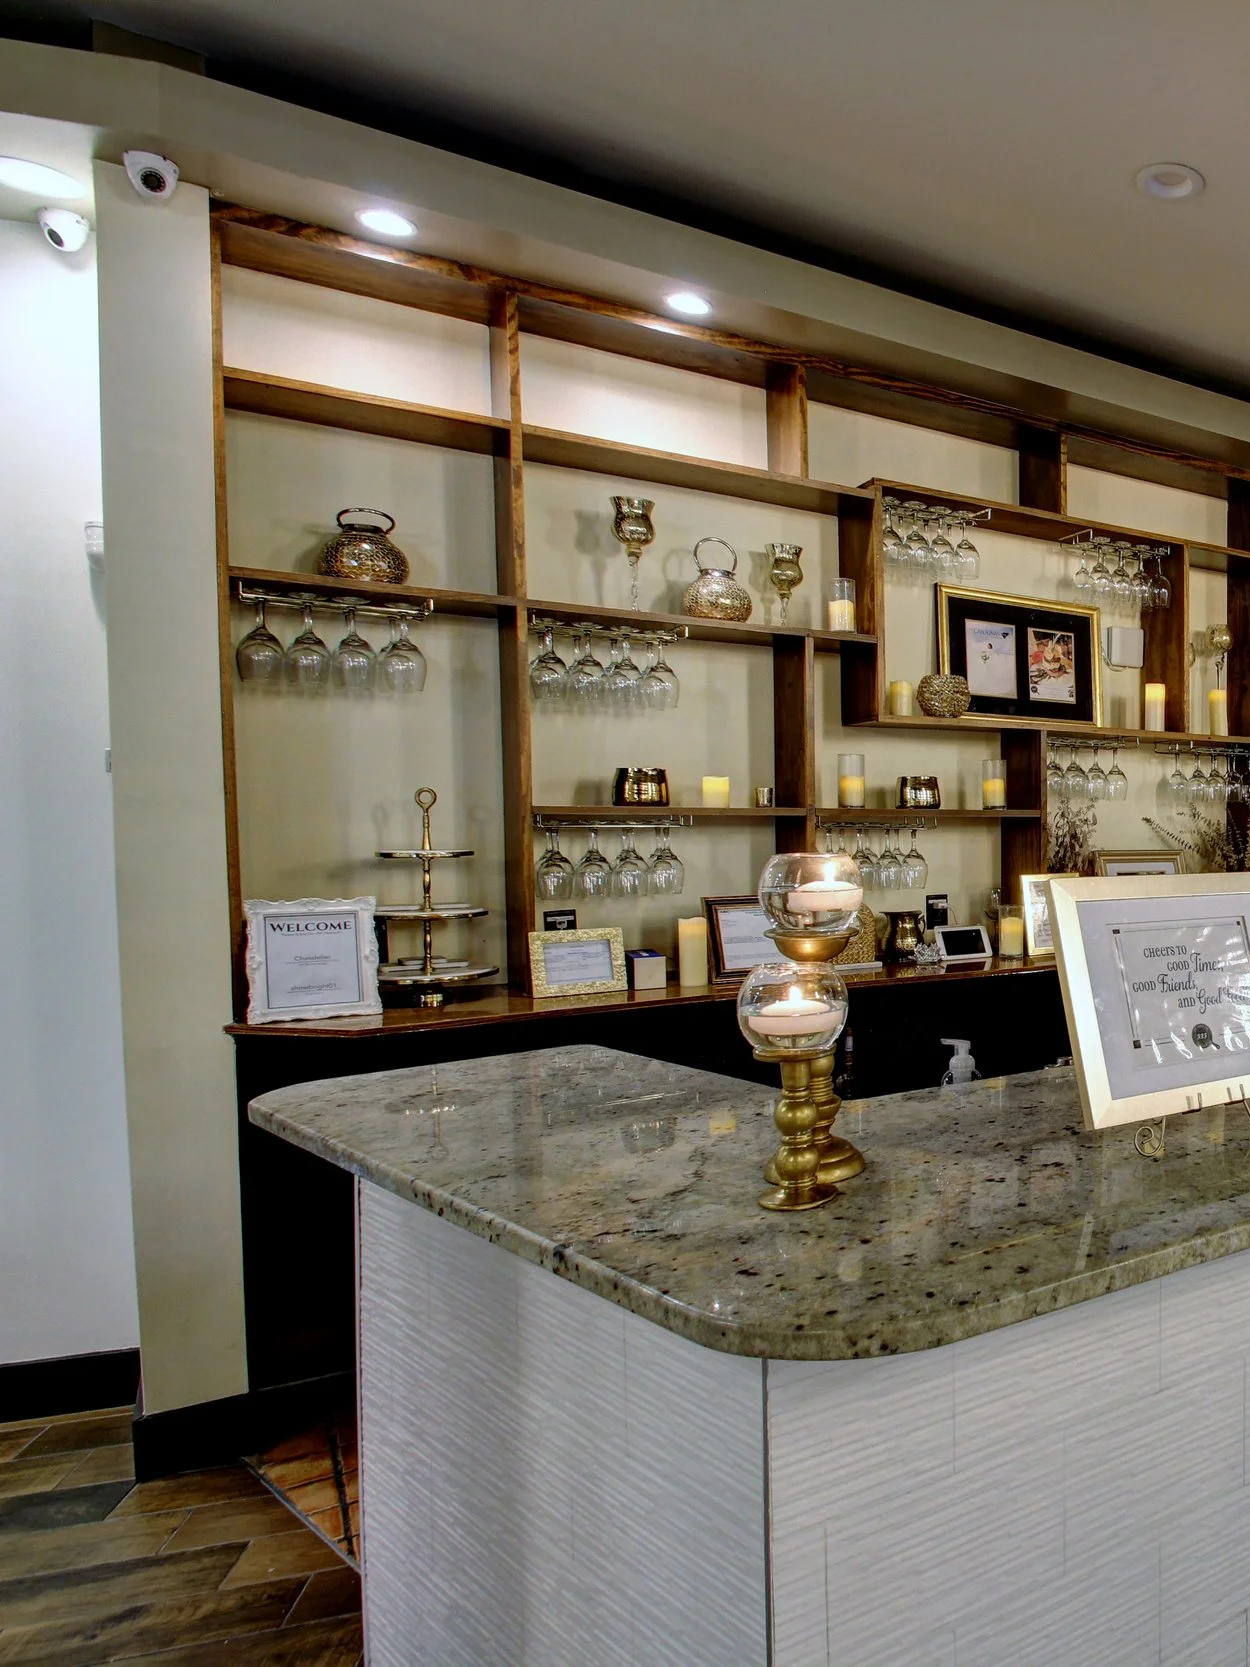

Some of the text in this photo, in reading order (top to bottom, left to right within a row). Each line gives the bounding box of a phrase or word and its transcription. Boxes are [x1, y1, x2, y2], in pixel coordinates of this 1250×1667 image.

[1175, 945, 1187, 955] TO
[1167, 960, 1190, 972] GOOD
[1132, 980, 1156, 993] GOOD
[1196, 988, 1223, 1015] Good
